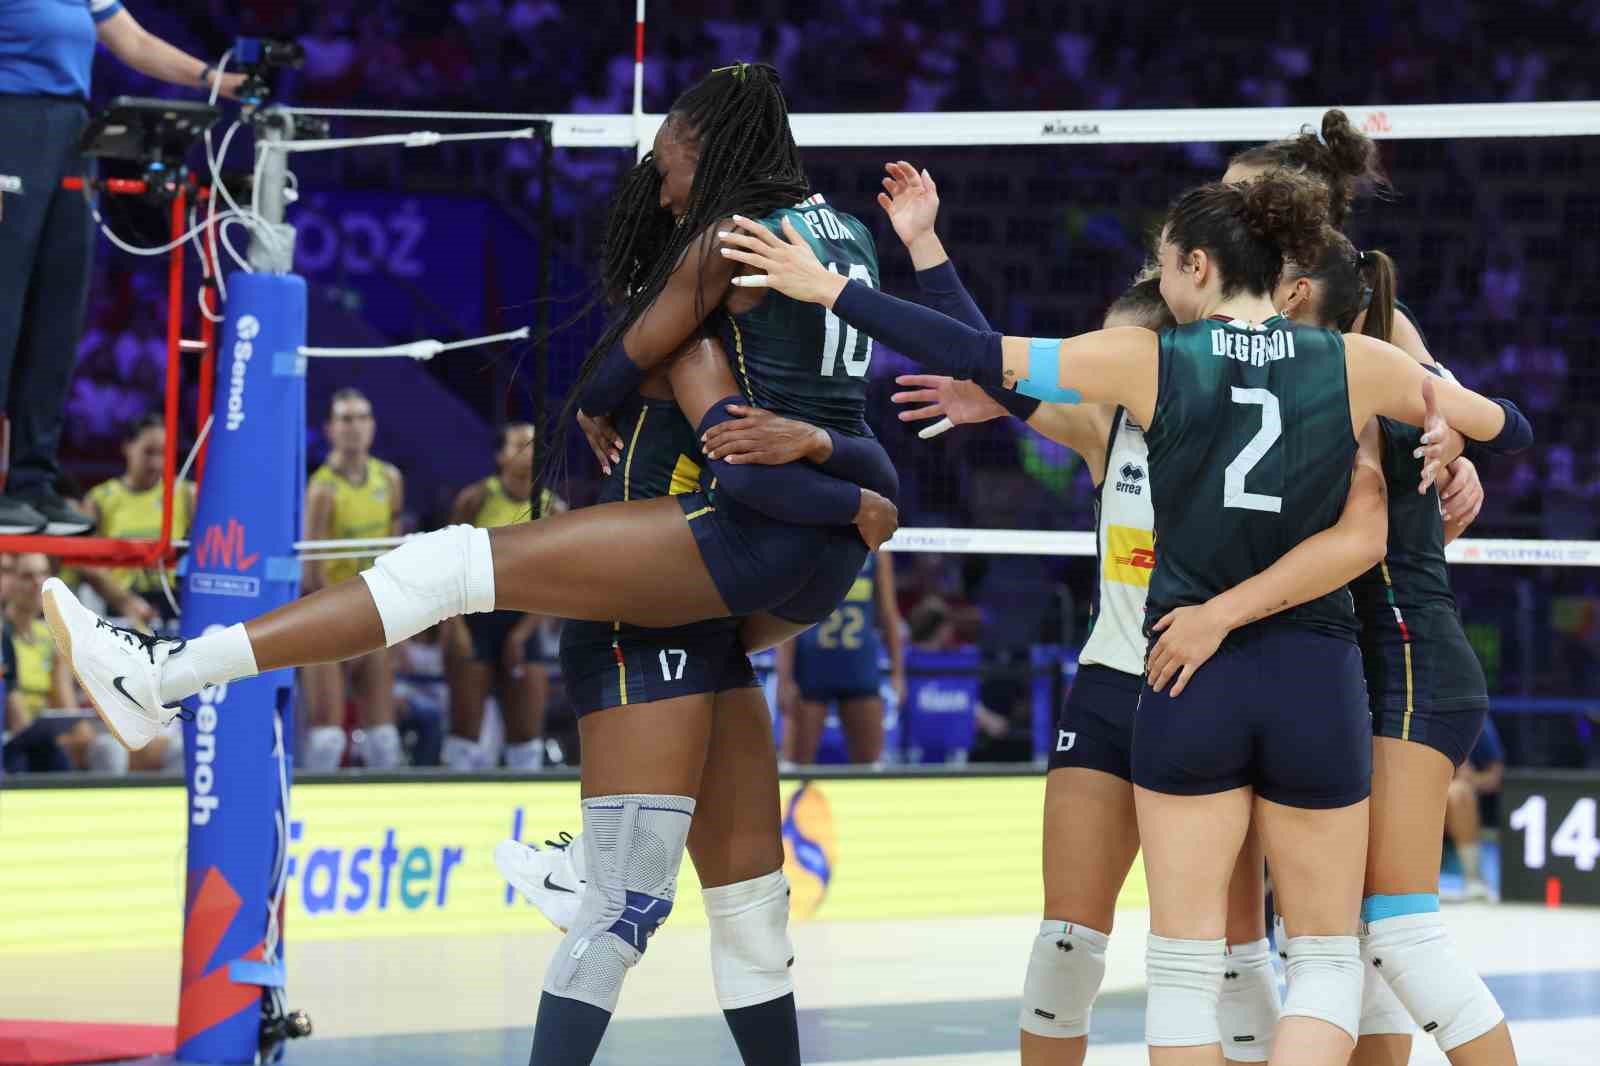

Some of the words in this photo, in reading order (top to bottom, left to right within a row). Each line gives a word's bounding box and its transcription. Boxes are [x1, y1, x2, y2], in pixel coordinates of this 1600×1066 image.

[820, 262, 874, 377] 10
[226, 340, 253, 431] Senoh
[1223, 386, 1283, 514] 2
[658, 649, 688, 681] 17
[818, 605, 865, 649] 22
[1510, 794, 1600, 872] 14
